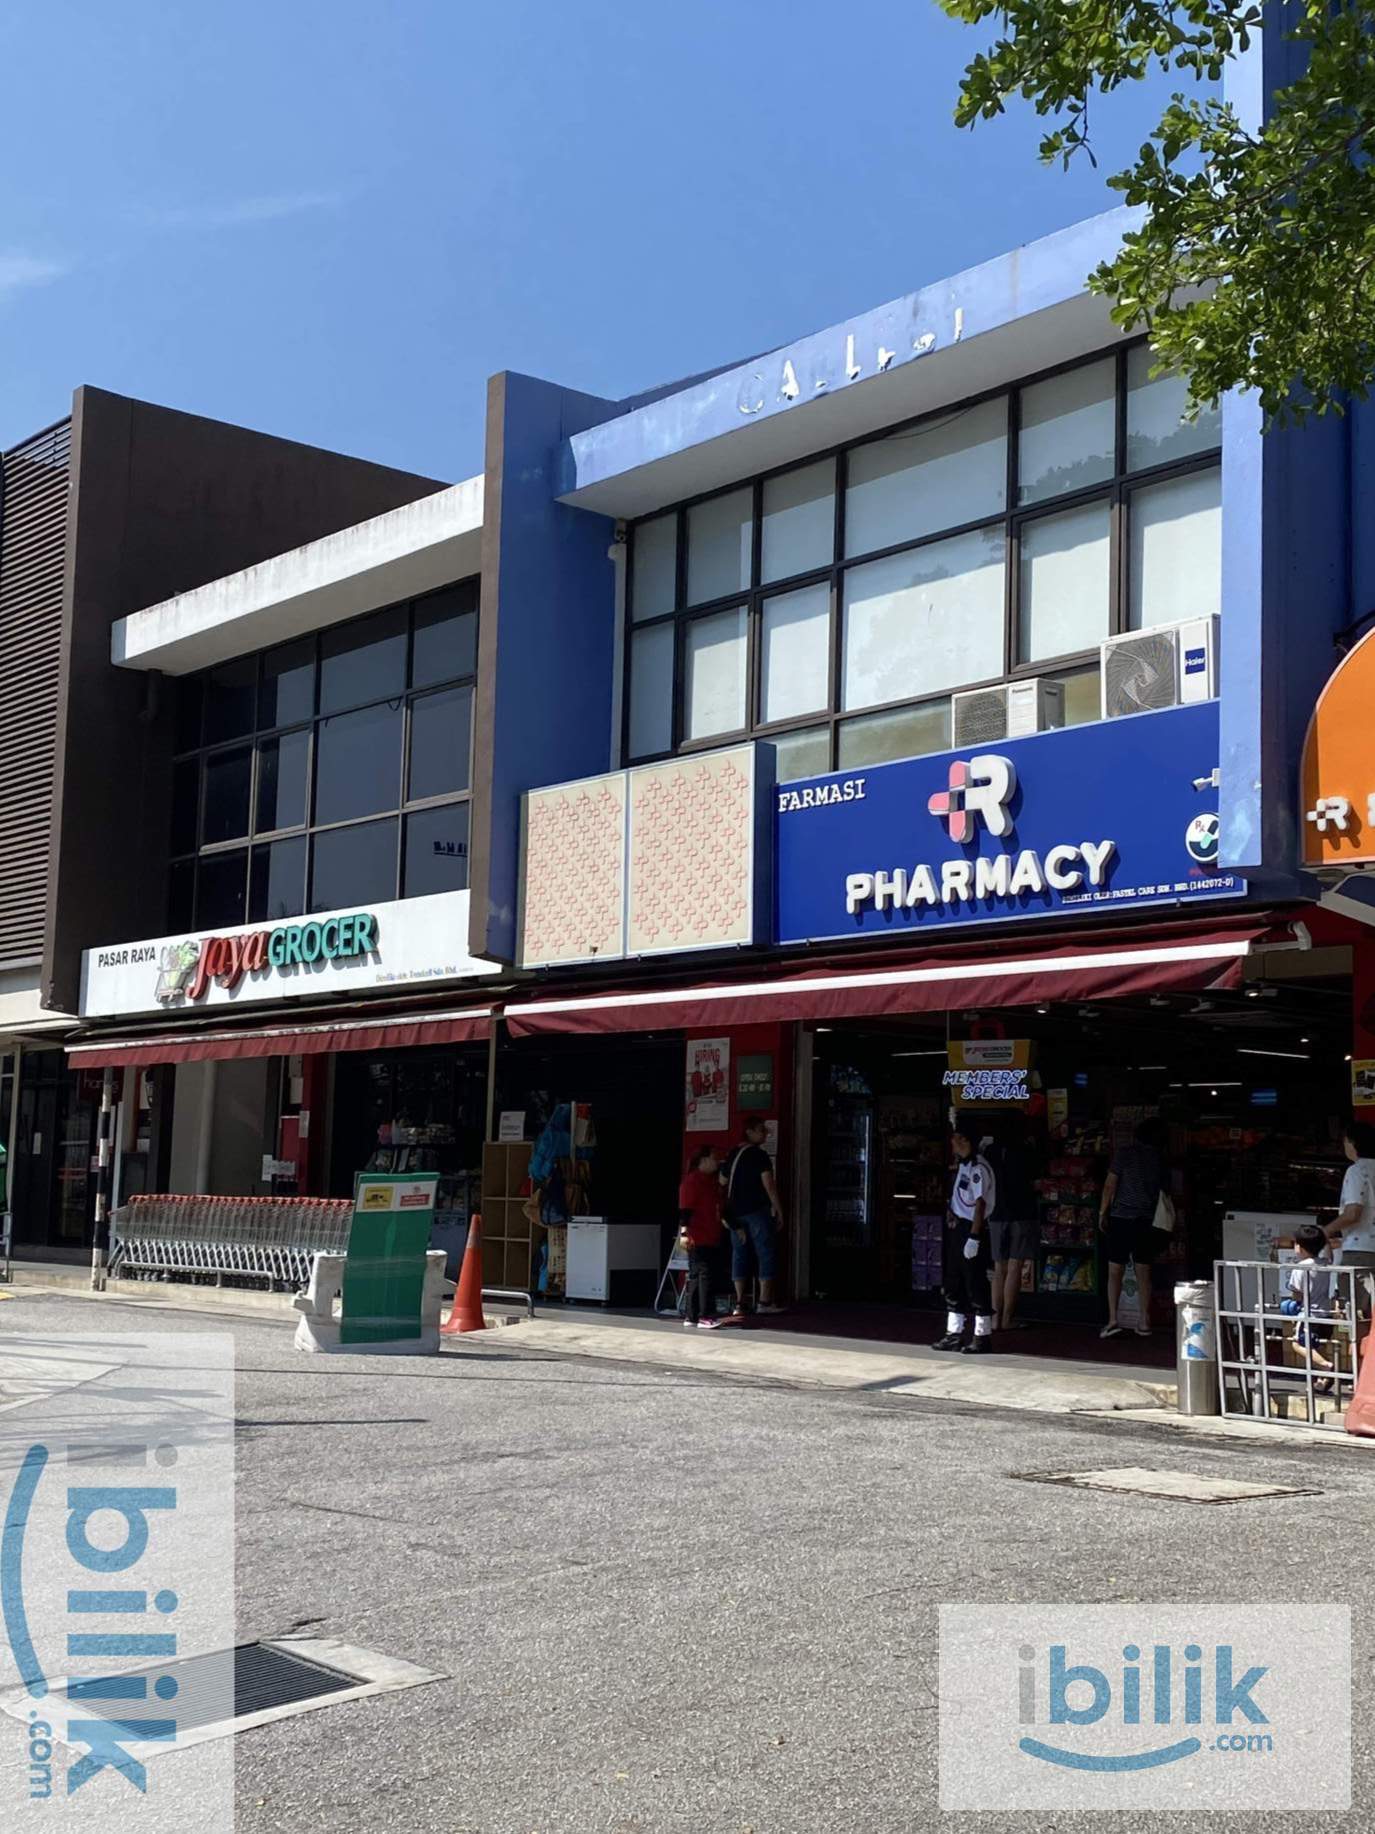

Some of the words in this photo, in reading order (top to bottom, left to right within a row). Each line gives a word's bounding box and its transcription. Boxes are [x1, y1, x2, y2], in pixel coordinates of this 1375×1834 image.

[778, 777, 866, 813] FARMASI
[846, 840, 1115, 915] PHARMACY
[98, 950, 128, 968] PASAR
[130, 946, 156, 964] RAYA
[186, 930, 271, 1000] Jaya
[267, 913, 378, 967] GROCER
[942, 1069, 1028, 1086] MEMBERS'
[960, 1084, 1030, 1100] SPECIAL
